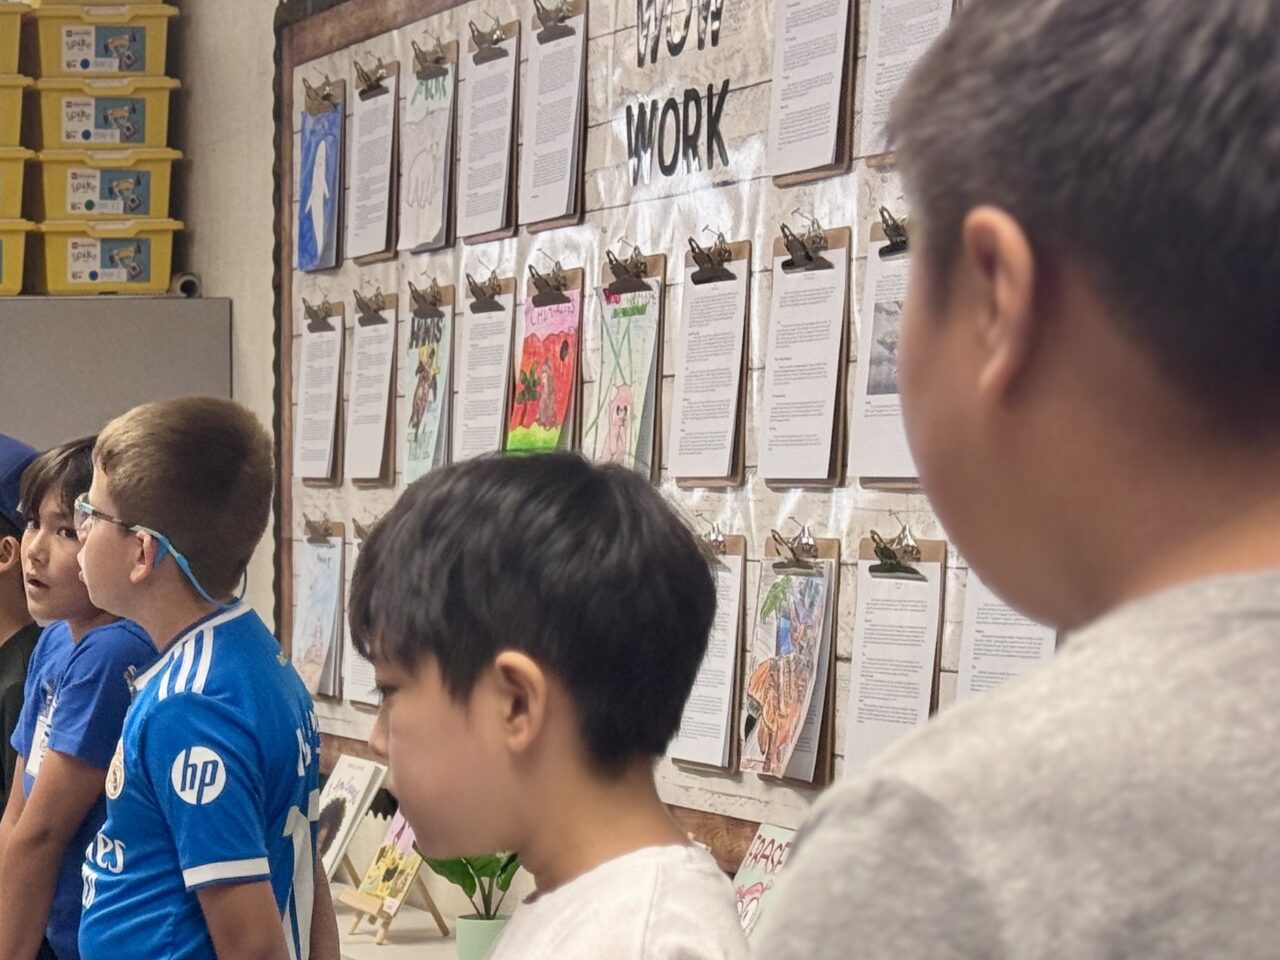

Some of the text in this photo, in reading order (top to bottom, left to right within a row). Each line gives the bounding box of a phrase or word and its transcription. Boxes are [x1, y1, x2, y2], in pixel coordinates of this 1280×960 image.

[636, 0, 724, 68] WOW
[625, 78, 731, 187] WORK
[181, 750, 220, 805] hp
